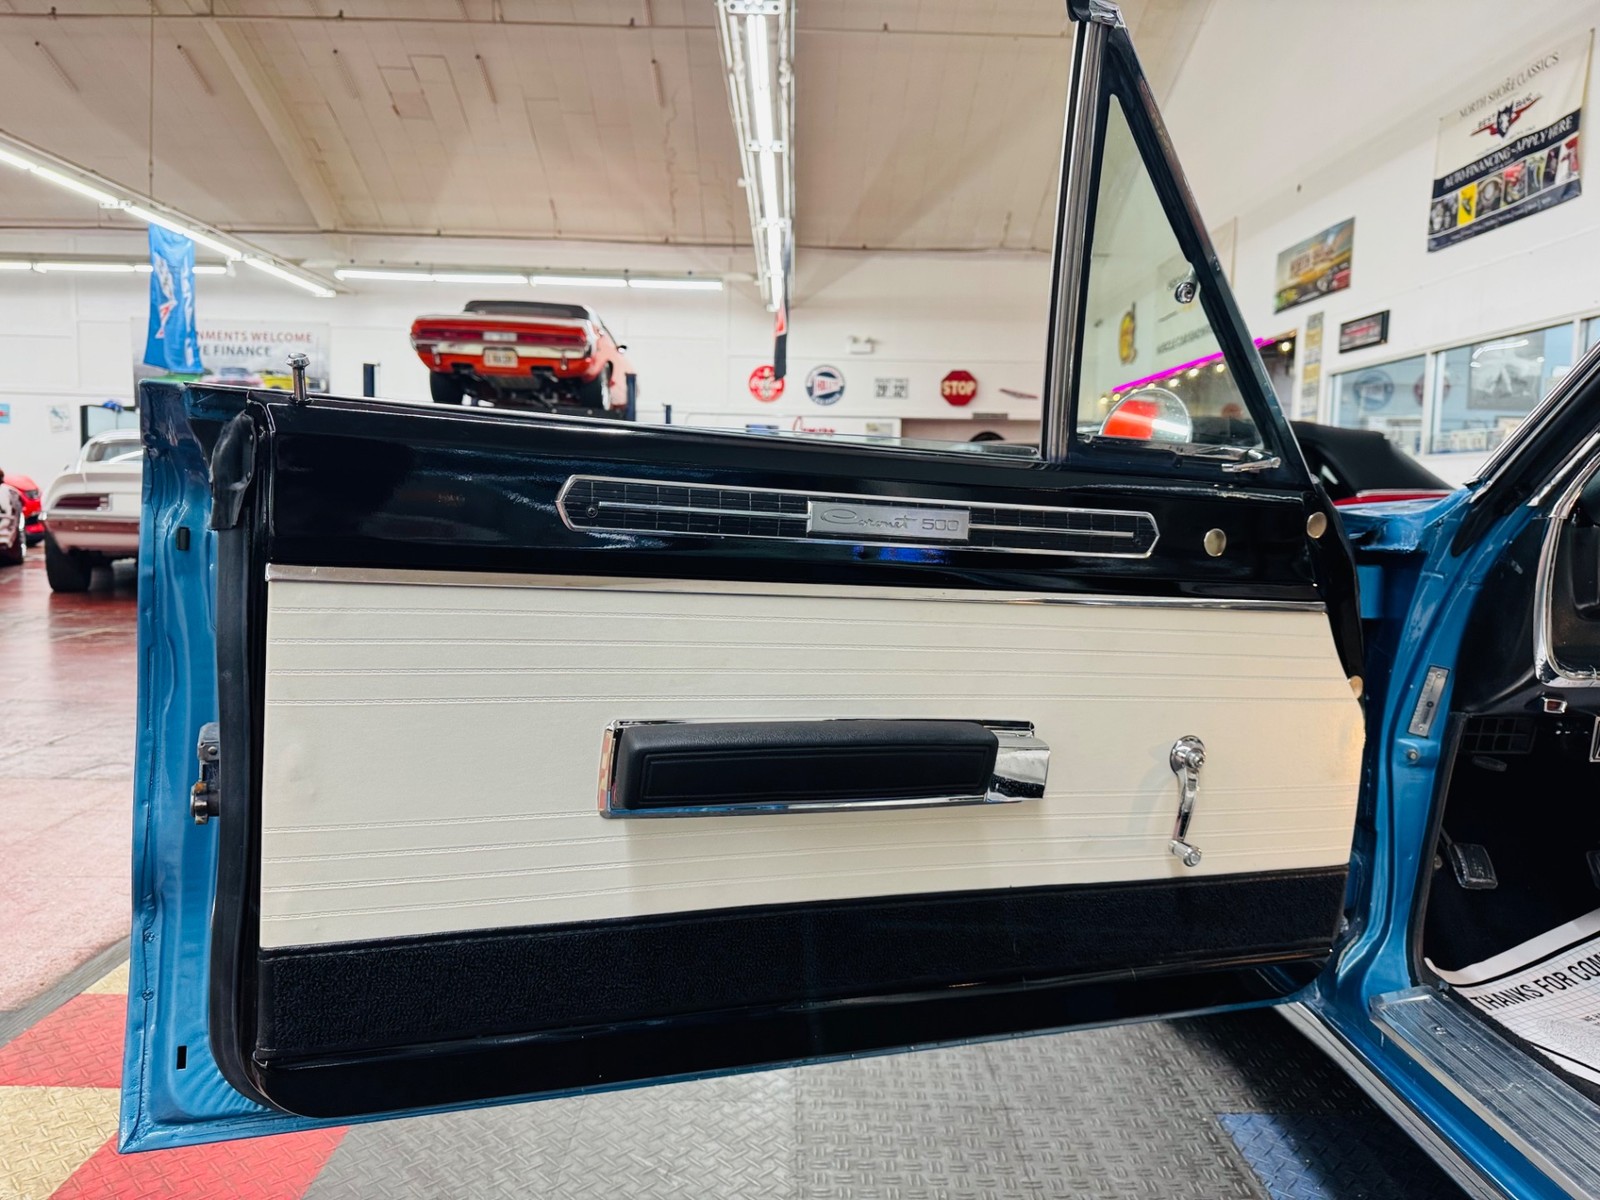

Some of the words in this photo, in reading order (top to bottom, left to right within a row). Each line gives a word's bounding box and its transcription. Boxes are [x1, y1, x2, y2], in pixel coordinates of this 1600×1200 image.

[1516, 51, 1560, 87] CLASSICS
[1443, 171, 1466, 190] AUTO
[1546, 115, 1574, 141] HERE
[196, 331, 248, 342] NMENTS
[251, 331, 312, 343] WELCOME
[213, 345, 271, 357] FINANCE
[943, 380, 976, 396] STOP
[820, 508, 917, 529] Coronet
[921, 518, 960, 532] 500
[1469, 984, 1544, 1011] THANKS
[1532, 972, 1579, 994] FOR
